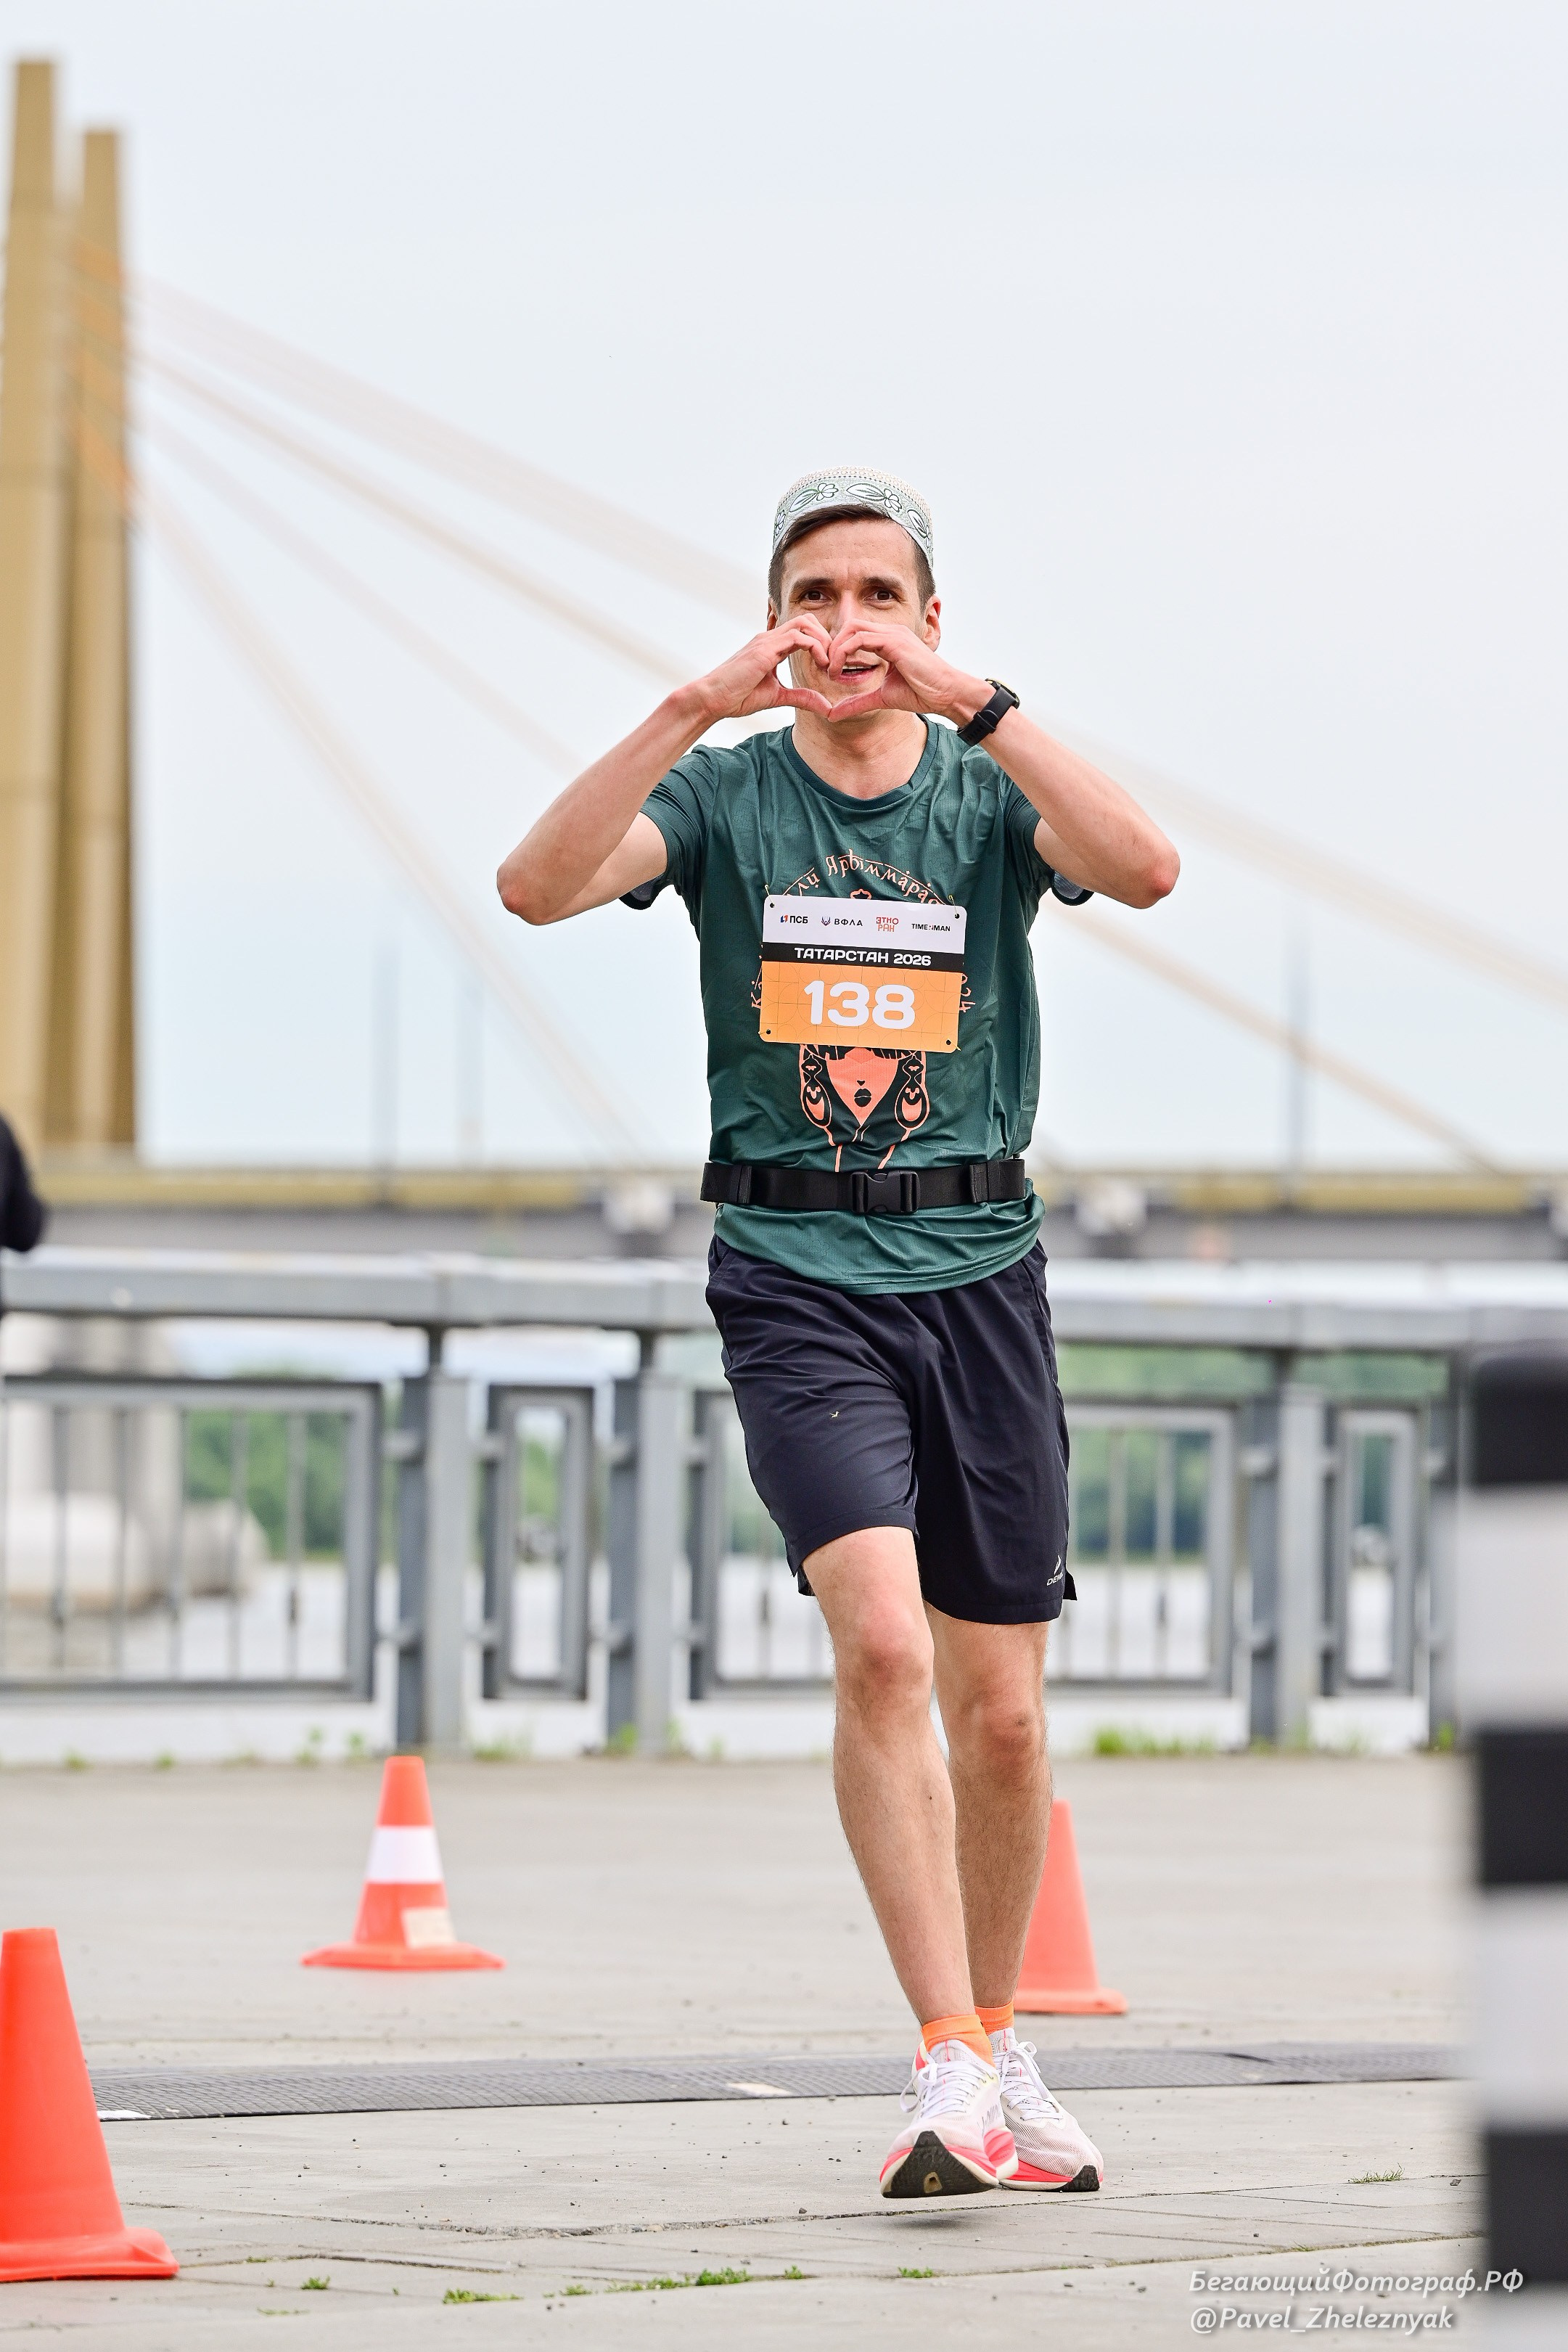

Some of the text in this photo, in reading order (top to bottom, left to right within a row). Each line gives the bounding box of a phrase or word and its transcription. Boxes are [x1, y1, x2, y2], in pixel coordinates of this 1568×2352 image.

[789, 915, 808, 924] ПСБ
[834, 918, 863, 927] ВФЛА
[877, 923, 895, 933] РАН
[794, 947, 932, 967] ТАТАРСТАН 2026
[803, 980, 916, 1030] 138
